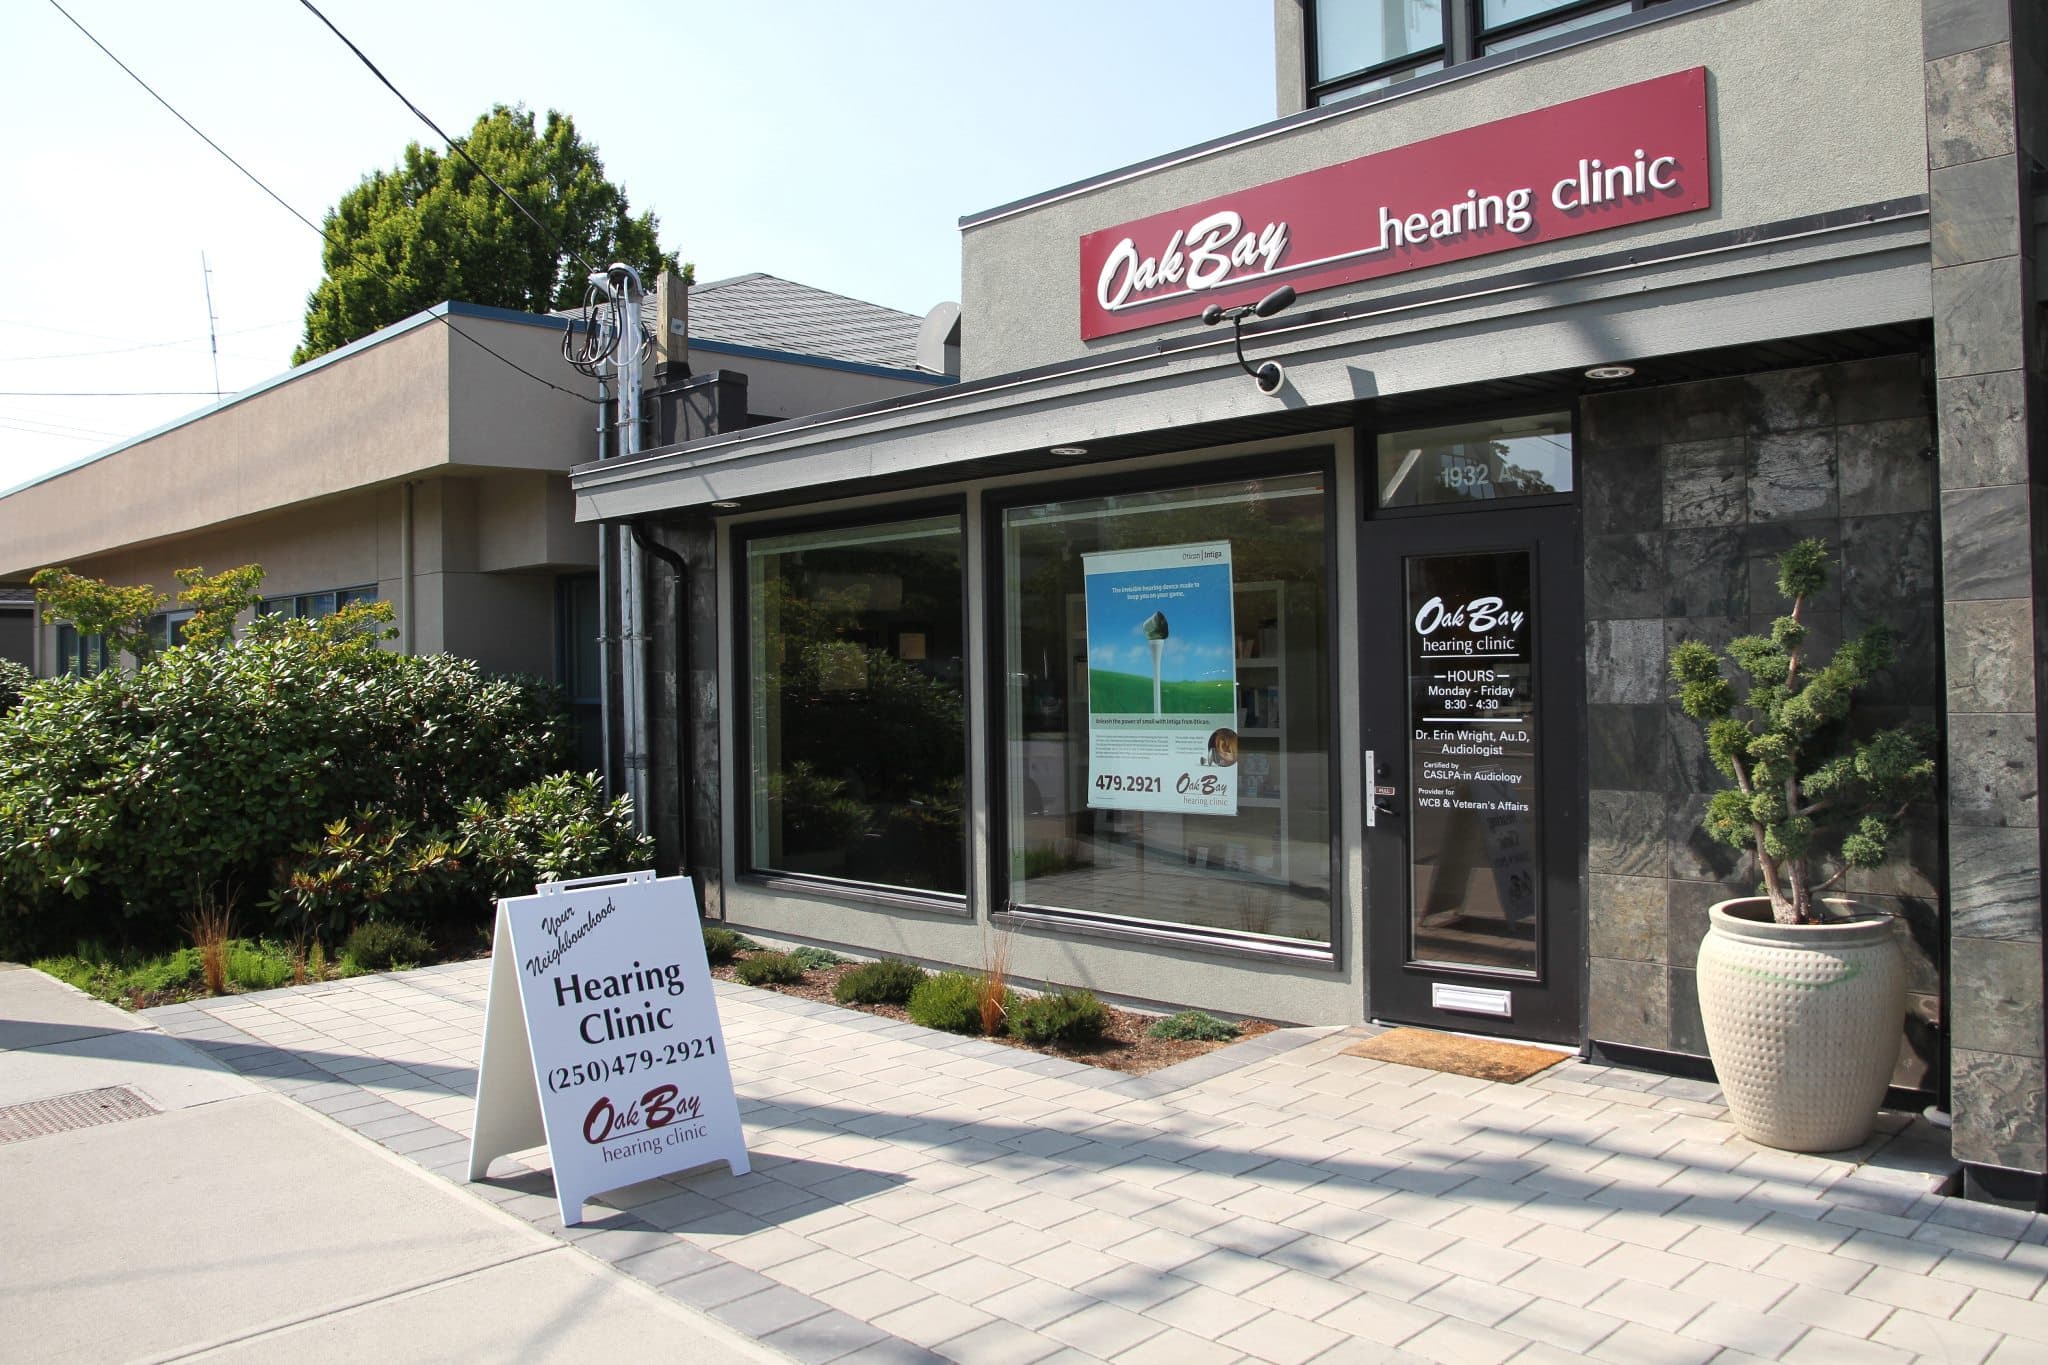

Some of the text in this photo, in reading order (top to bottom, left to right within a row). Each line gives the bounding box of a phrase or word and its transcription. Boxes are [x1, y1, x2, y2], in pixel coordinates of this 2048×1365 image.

[1097, 149, 1677, 310] Oak Bay hearing clinic
[1441, 464, 1489, 488] 1932
[1204, 551, 1222, 560] Intiga
[1415, 596, 1524, 635] Oak Bay
[1423, 635, 1515, 655] hearing clinic
[1447, 670, 1495, 682] HOURS
[1428, 685, 1471, 698] Monday
[1481, 685, 1515, 697] Friday
[1444, 699, 1467, 710] 8:30
[1475, 699, 1498, 710] 4:30
[1415, 729, 1431, 740] Dr.
[1433, 730, 1454, 741] Erin
[1457, 730, 1496, 743] Wright,
[1441, 743, 1503, 757] Audiologist
[1423, 761, 1459, 770] Certified by
[1096, 774, 1161, 793] 479.2921
[1176, 772, 1228, 796] Oak Bay
[1423, 770, 1522, 784] CASLPA in Audiology
[1418, 787, 1455, 796] Provider for
[1183, 796, 1229, 807] hearing clinic
[1418, 798, 1529, 812] WCB & Veteran's Affairs
[541, 903, 576, 937] Your
[526, 896, 616, 977] Neighbourhood
[553, 960, 685, 1007] Hearing
[579, 1001, 674, 1045] Clinic
[548, 1035, 717, 1093] (250)479-2921
[583, 1083, 702, 1145] Oak Bay
[601, 1123, 709, 1163] hearing clinic
